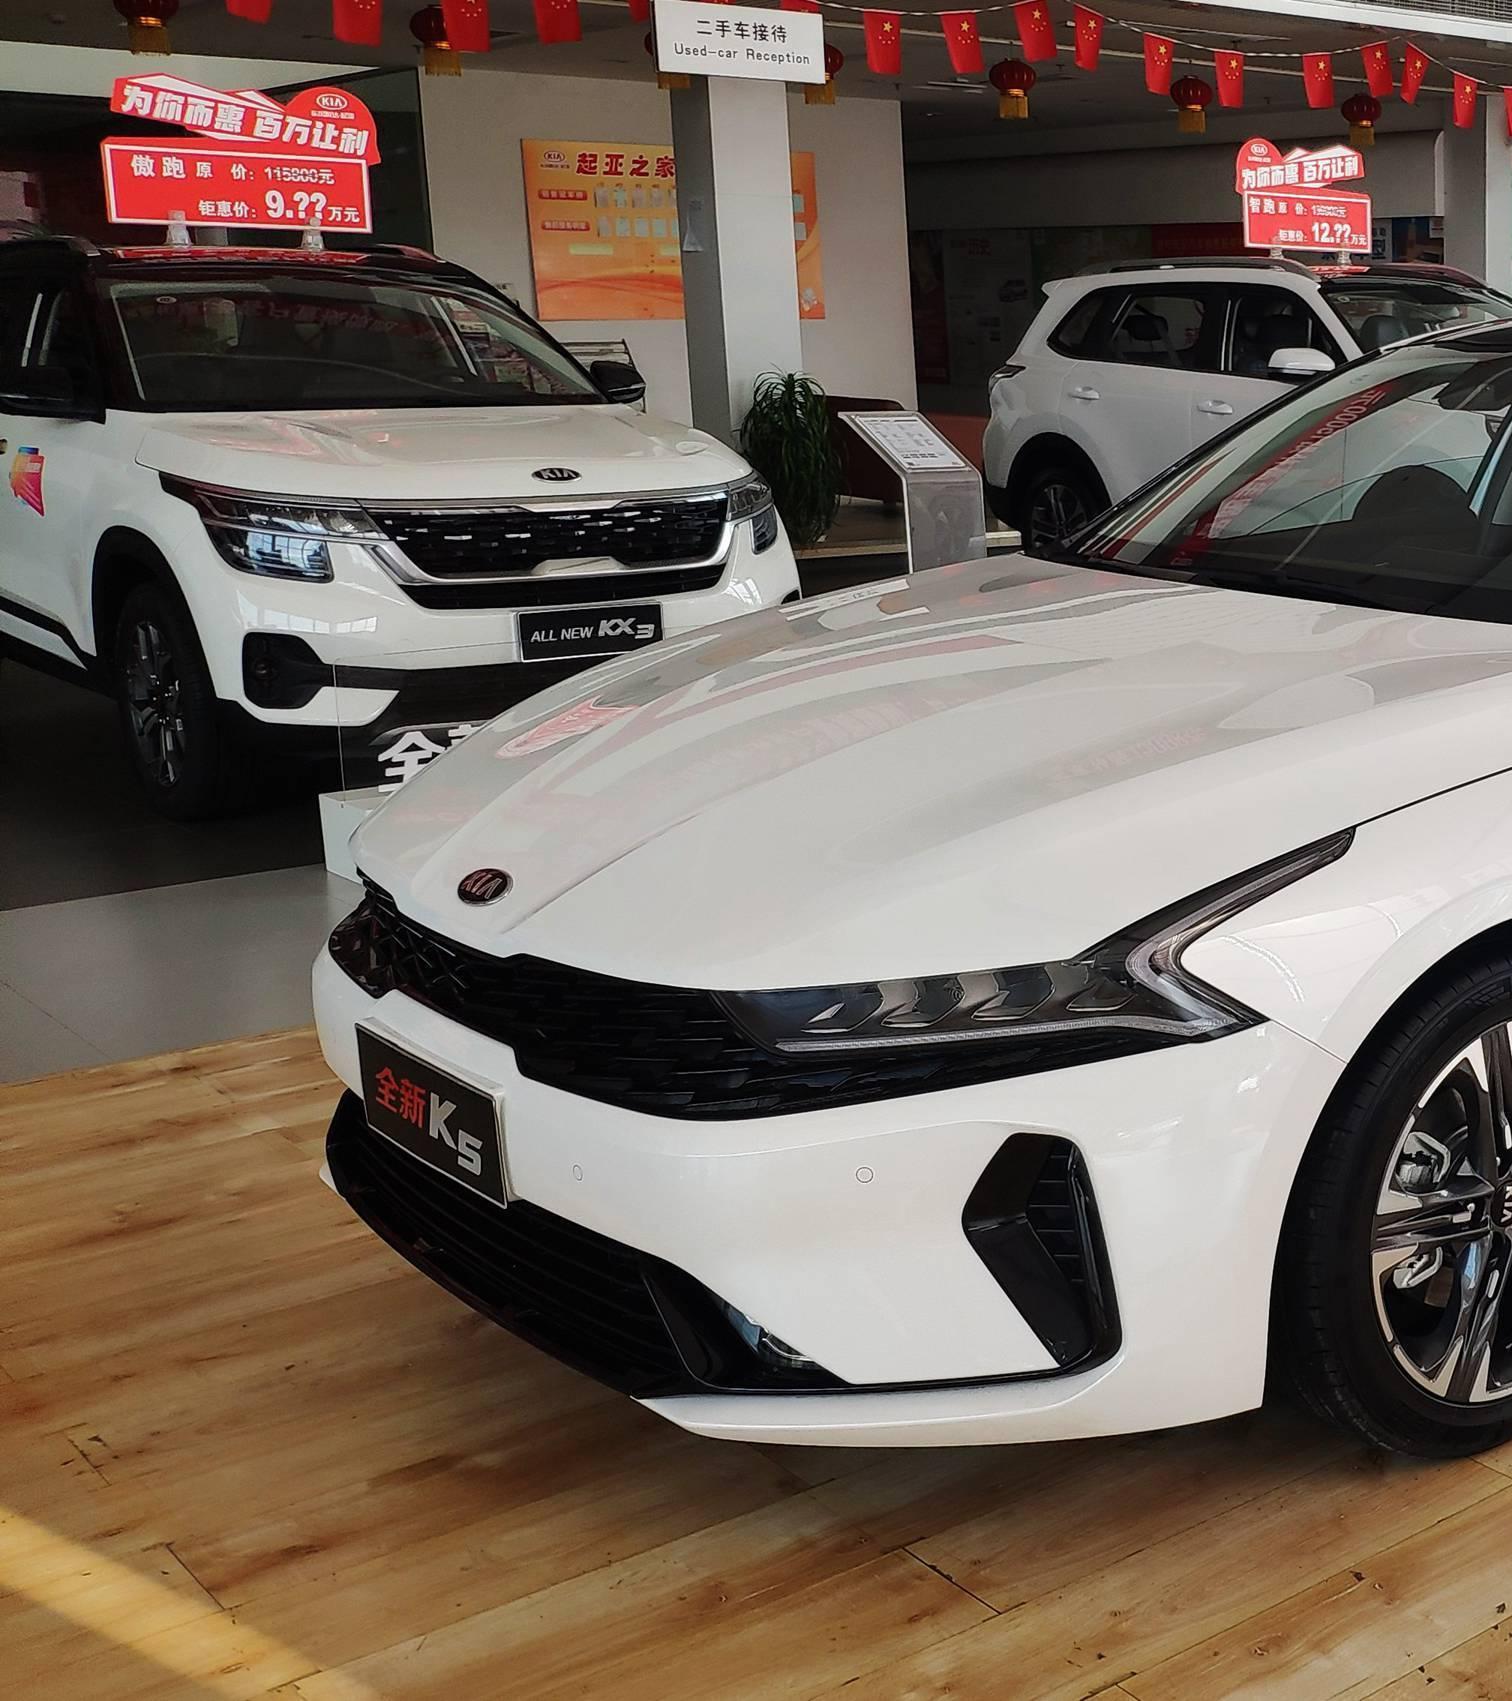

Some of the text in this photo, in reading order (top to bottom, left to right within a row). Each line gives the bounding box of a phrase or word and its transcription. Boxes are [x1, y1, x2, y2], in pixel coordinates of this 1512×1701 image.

[697, 19, 788, 44] 二手车接待
[673, 42, 811, 65] Used-car Reception
[121, 83, 370, 158] 为你而惠 百万让利
[575, 152, 676, 179] 起亚之家
[1303, 155, 1359, 183] 百万让利
[530, 617, 656, 643] ALL NEW KX3
